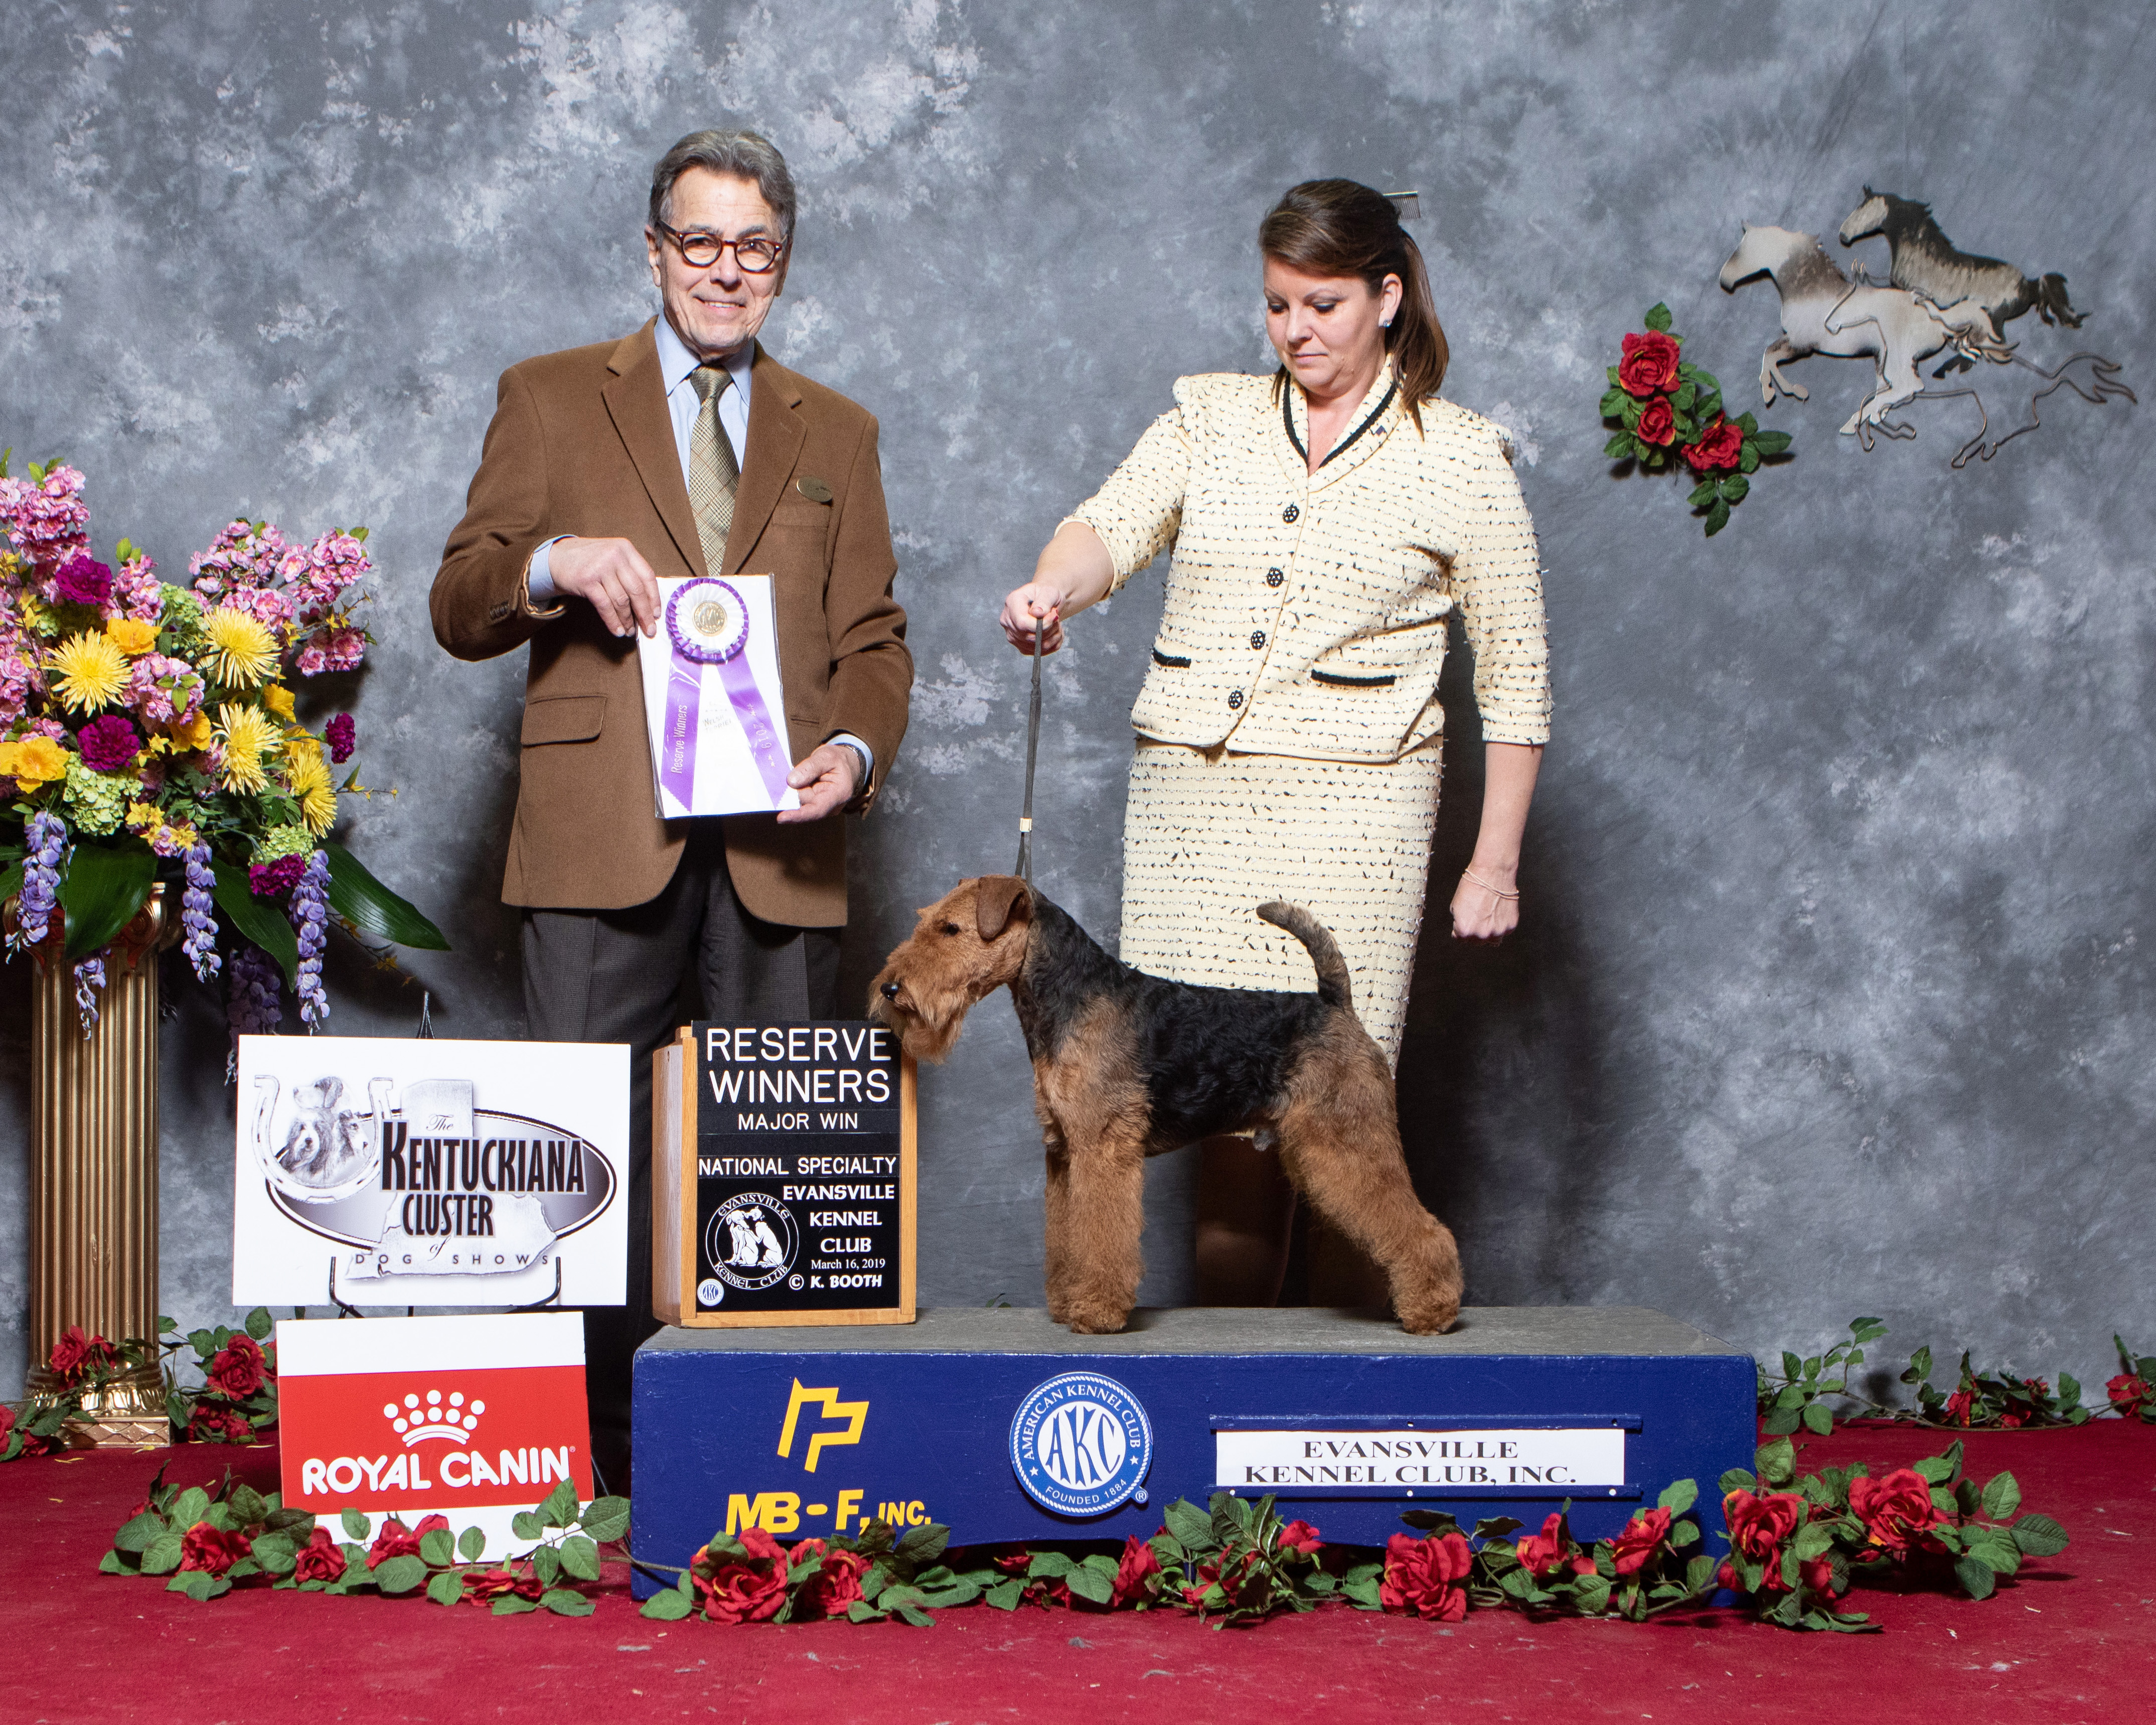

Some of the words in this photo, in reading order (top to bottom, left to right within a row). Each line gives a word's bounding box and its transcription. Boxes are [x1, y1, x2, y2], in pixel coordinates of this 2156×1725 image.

[673, 704, 688, 738] Winners
[753, 723, 772, 750] 2019
[671, 740, 685, 774] Reserve
[707, 1028, 891, 1062] RESERVE
[709, 1069, 890, 1103] WINNERS
[426, 1114, 454, 1131] The
[738, 1112, 809, 1130] MAJOR
[820, 1112, 858, 1129] WIN
[381, 1120, 585, 1193] KENTUCKIANA
[699, 1158, 790, 1176] NATIONAL
[798, 1157, 896, 1175] SPECIALTY
[783, 1184, 895, 1200] EVANSVILLE
[402, 1193, 494, 1236] CLUSTER
[718, 1195, 790, 1219] EVANSVILLE
[810, 1211, 882, 1227] KENNEL
[427, 1235, 451, 1262] of
[820, 1237, 872, 1253] CLUB
[356, 1254, 412, 1264] DOG
[452, 1254, 548, 1264] SHOWS
[811, 1259, 842, 1269] March
[845, 1258, 859, 1270] 16,
[862, 1258, 886, 1269] 2019
[714, 1261, 751, 1288] KENNEL
[760, 1265, 788, 1286] CLUB
[810, 1275, 825, 1288] K.
[829, 1274, 882, 1288] BOOTH
[703, 1284, 718, 1301] AKC
[1022, 1389, 1063, 1461] AMERICAN
[1066, 1384, 1123, 1411] KENNEL
[1121, 1410, 1141, 1448] CLUB
[1045, 1404, 1121, 1488] AKC
[1303, 1441, 1518, 1459] EVANSVILLE
[302, 1453, 432, 1496] ROYAL
[1244, 1466, 1386, 1484] KENNEL
[1395, 1466, 1496, 1486] CLUB,
[1506, 1466, 1576, 1484] INC.
[1045, 1486, 1100, 1505] FOUNDED
[1104, 1479, 1127, 1498] 1884
[878, 1500, 931, 1526] INC.
